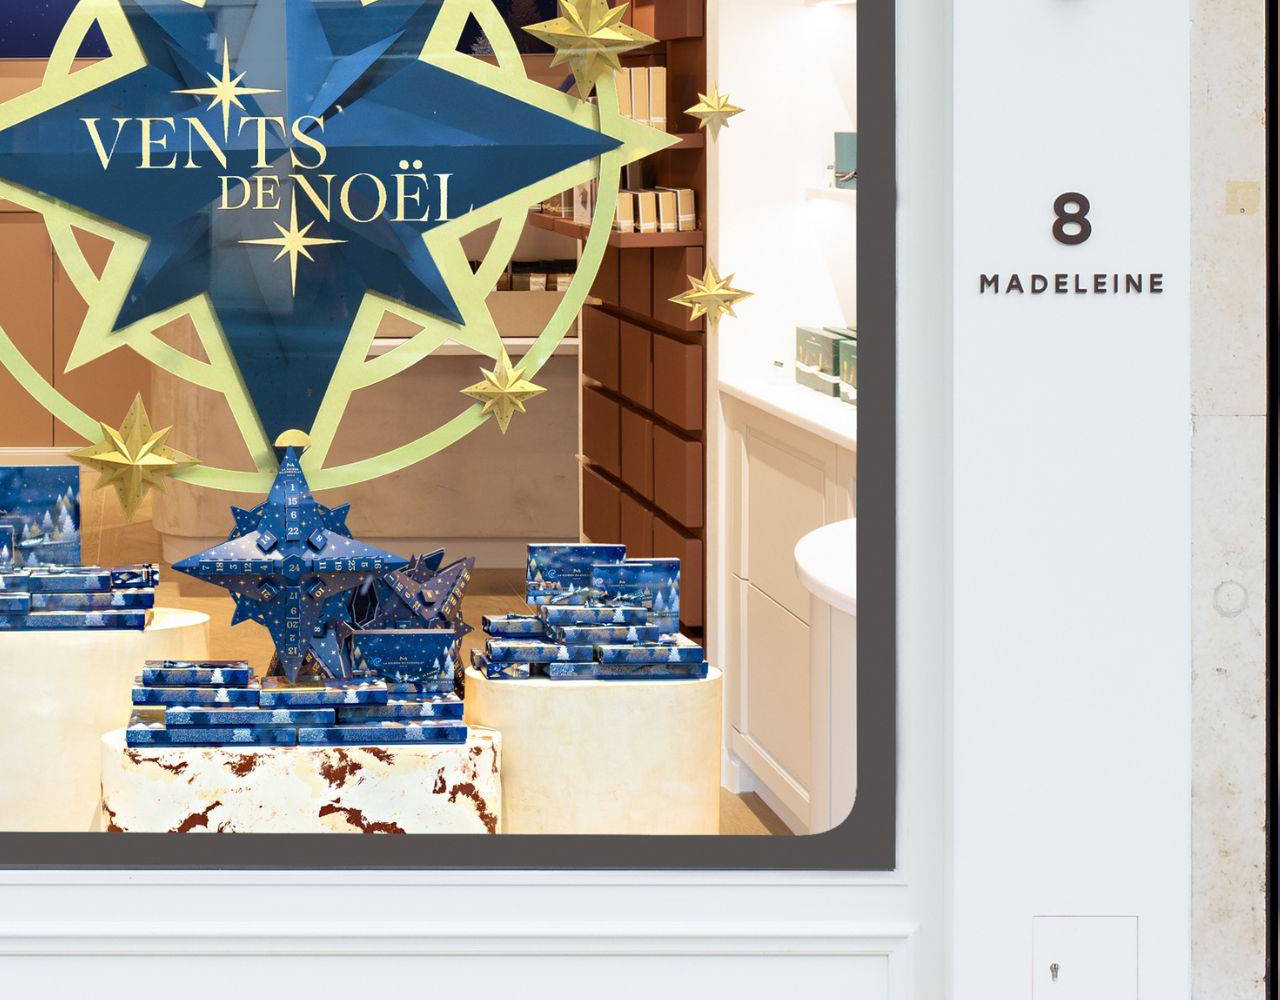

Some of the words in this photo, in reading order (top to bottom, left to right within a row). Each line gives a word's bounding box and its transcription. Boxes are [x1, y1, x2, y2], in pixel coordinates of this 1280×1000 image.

[79, 114, 328, 171] VENTS
[216, 175, 281, 211] DE
[289, 159, 474, 223] NOËL
[1051, 191, 1093, 247] 8
[979, 273, 1164, 295] MADELEINE
[287, 497, 298, 506] 15
[290, 510, 297, 519] 6
[287, 527, 300, 535] 22
[215, 560, 224, 572] 18
[244, 562, 252, 573] 12
[288, 563, 301, 572] 24
[319, 562, 327, 570] 11
[334, 561, 343, 571] 19
[289, 591, 298, 600] 17
[315, 587, 325, 598] 10
[286, 621, 299, 629] 20
[289, 634, 296, 642] 2
[287, 646, 298, 655] 13
